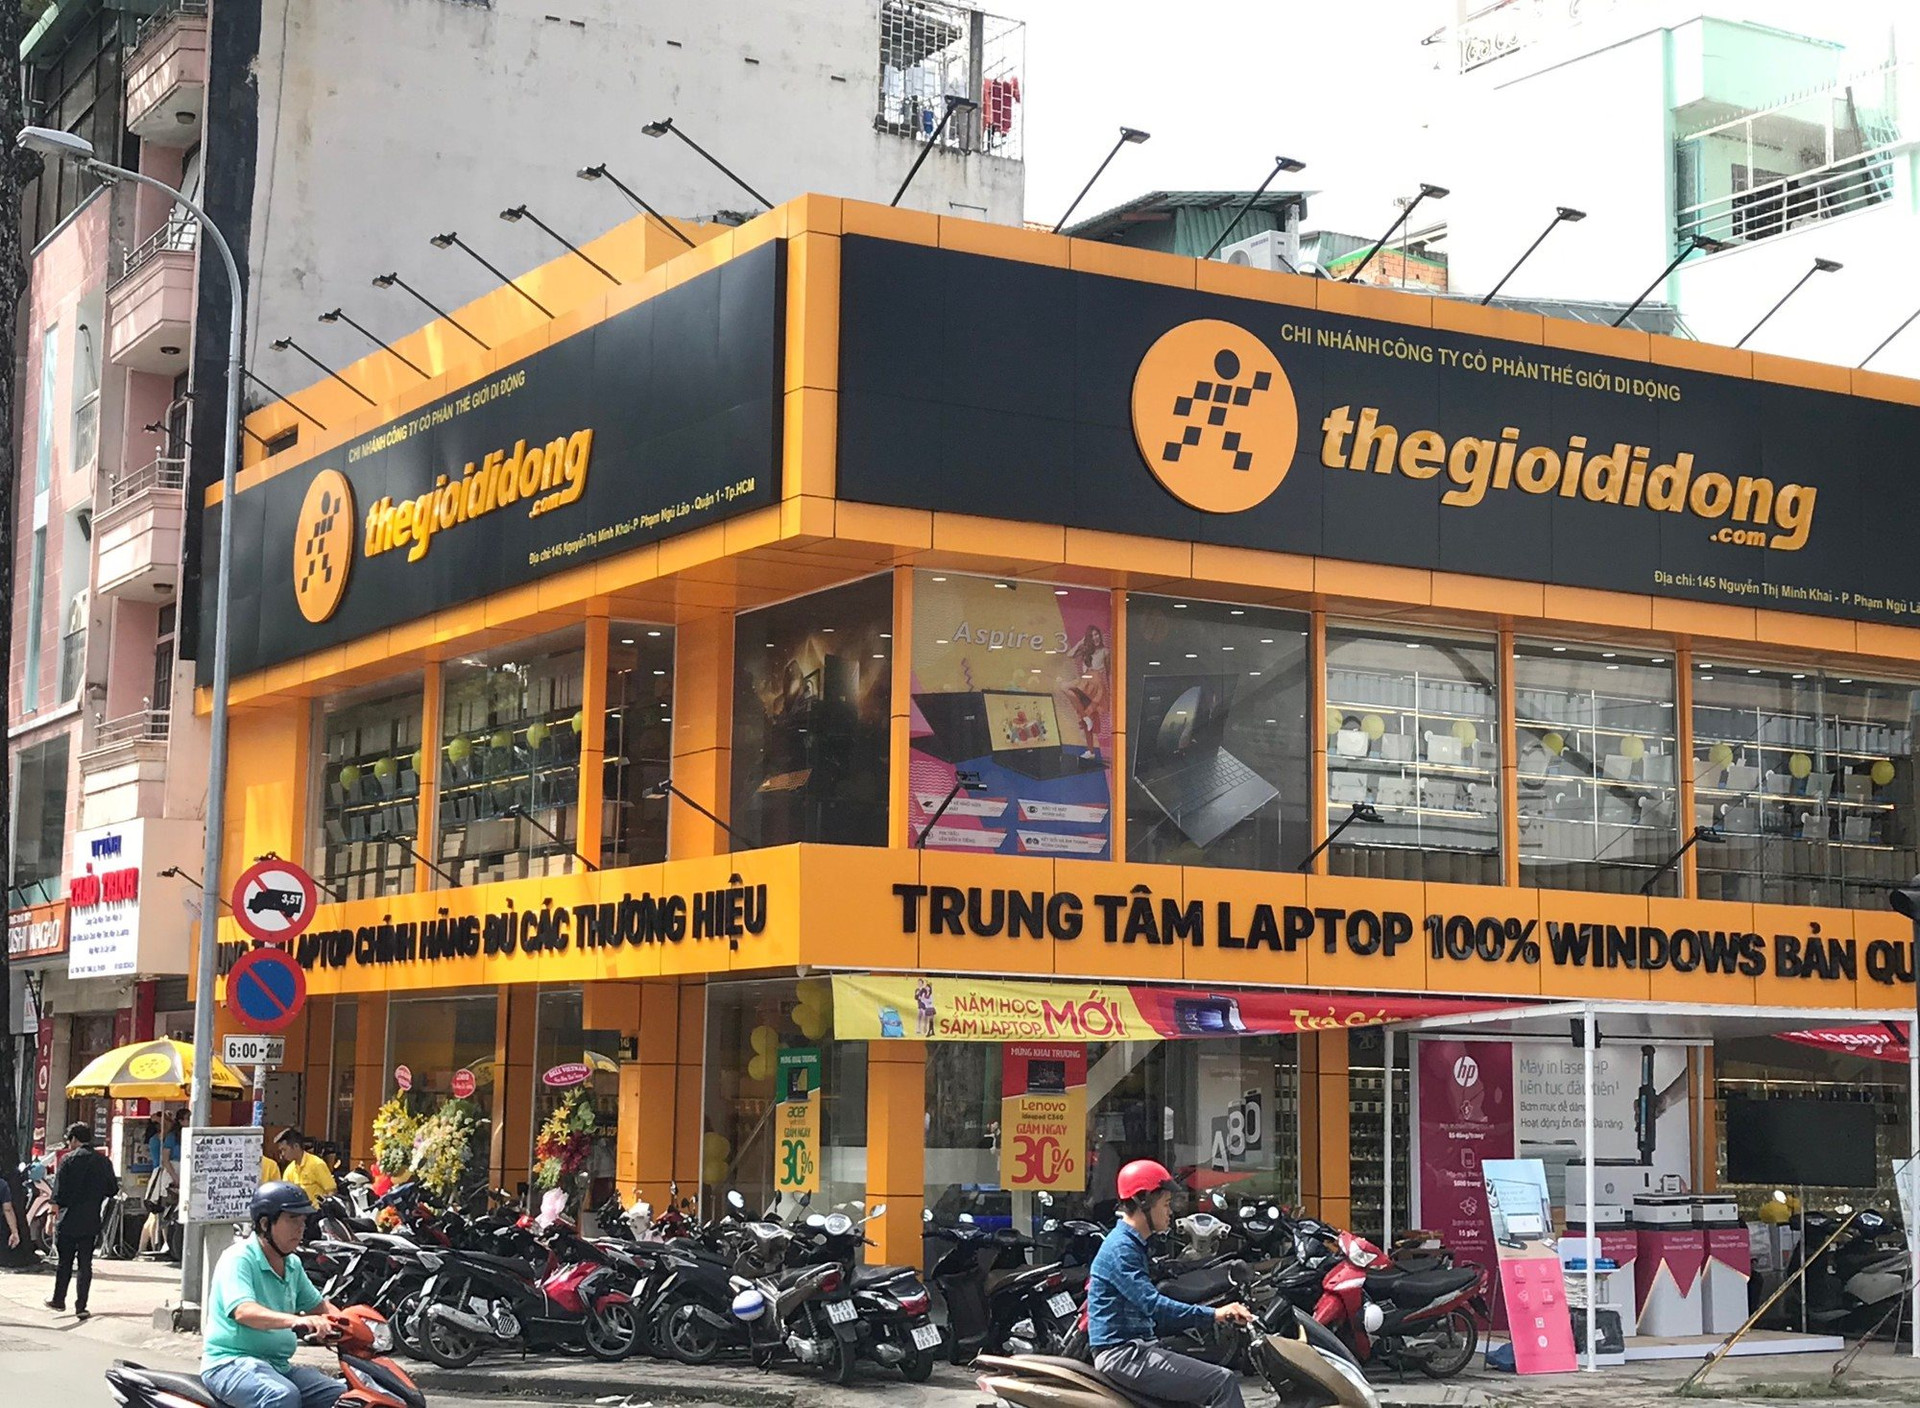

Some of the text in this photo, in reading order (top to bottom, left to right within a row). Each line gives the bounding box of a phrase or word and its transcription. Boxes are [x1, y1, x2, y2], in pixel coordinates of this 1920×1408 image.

[1281, 323, 1312, 344] CHI
[1317, 329, 1380, 355] NHÁNH
[1382, 337, 1433, 363] CÔNG
[1438, 347, 1460, 367] TY
[1575, 369, 1611, 391] GIỚI
[1615, 376, 1630, 394] DI
[1633, 378, 1681, 402] ĐỘNG
[409, 419, 419, 437] TY
[491, 382, 499, 399] DI
[725, 477, 755, 502] Tp.HCM
[1321, 404, 1819, 552] thegioididong
[364, 428, 594, 563] thegioididong
[1709, 526, 1768, 547] .com
[1654, 570, 1673, 586] Địa
[1697, 575, 1716, 588] 145
[1761, 582, 1779, 599] Thị
[1781, 585, 1807, 599] Minh
[1809, 588, 1832, 602] Khai
[1853, 594, 1883, 611] Phạm
[1886, 599, 1907, 614] Ngũ
[953, 622, 1069, 653] Aspire 3
[281, 893, 302, 905] 3,5T
[355, 914, 417, 965] CHÍNH
[520, 897, 569, 952] CÁC
[573, 892, 687, 949] THƯƠNG
[692, 873, 767, 950] HIỆU
[893, 884, 1083, 941] TRUNG
[1094, 883, 1204, 946] TÂM
[1218, 902, 1413, 957] LAPTOP
[1424, 914, 1540, 964] 100%
[1546, 920, 1767, 977] WINDOWS
[1775, 921, 1857, 981] BẢN
[954, 992, 1039, 1018] NĂM HỌC
[1041, 989, 1126, 1036] MỚI
[1290, 1006, 1344, 1030] Trả
[980, 1019, 1042, 1036] LAPTOP
[229, 1042, 257, 1058] 6:00
[1456, 1056, 1477, 1087] hp
[1547, 1061, 1557, 1074] in
[1560, 1060, 1585, 1075] lase
[787, 1106, 808, 1118] acer
[1021, 1099, 1067, 1112] Lenovo
[1042, 1123, 1068, 1136] NGAY
[780, 1139, 814, 1186] 30%
[1010, 1135, 1075, 1184] 30%
